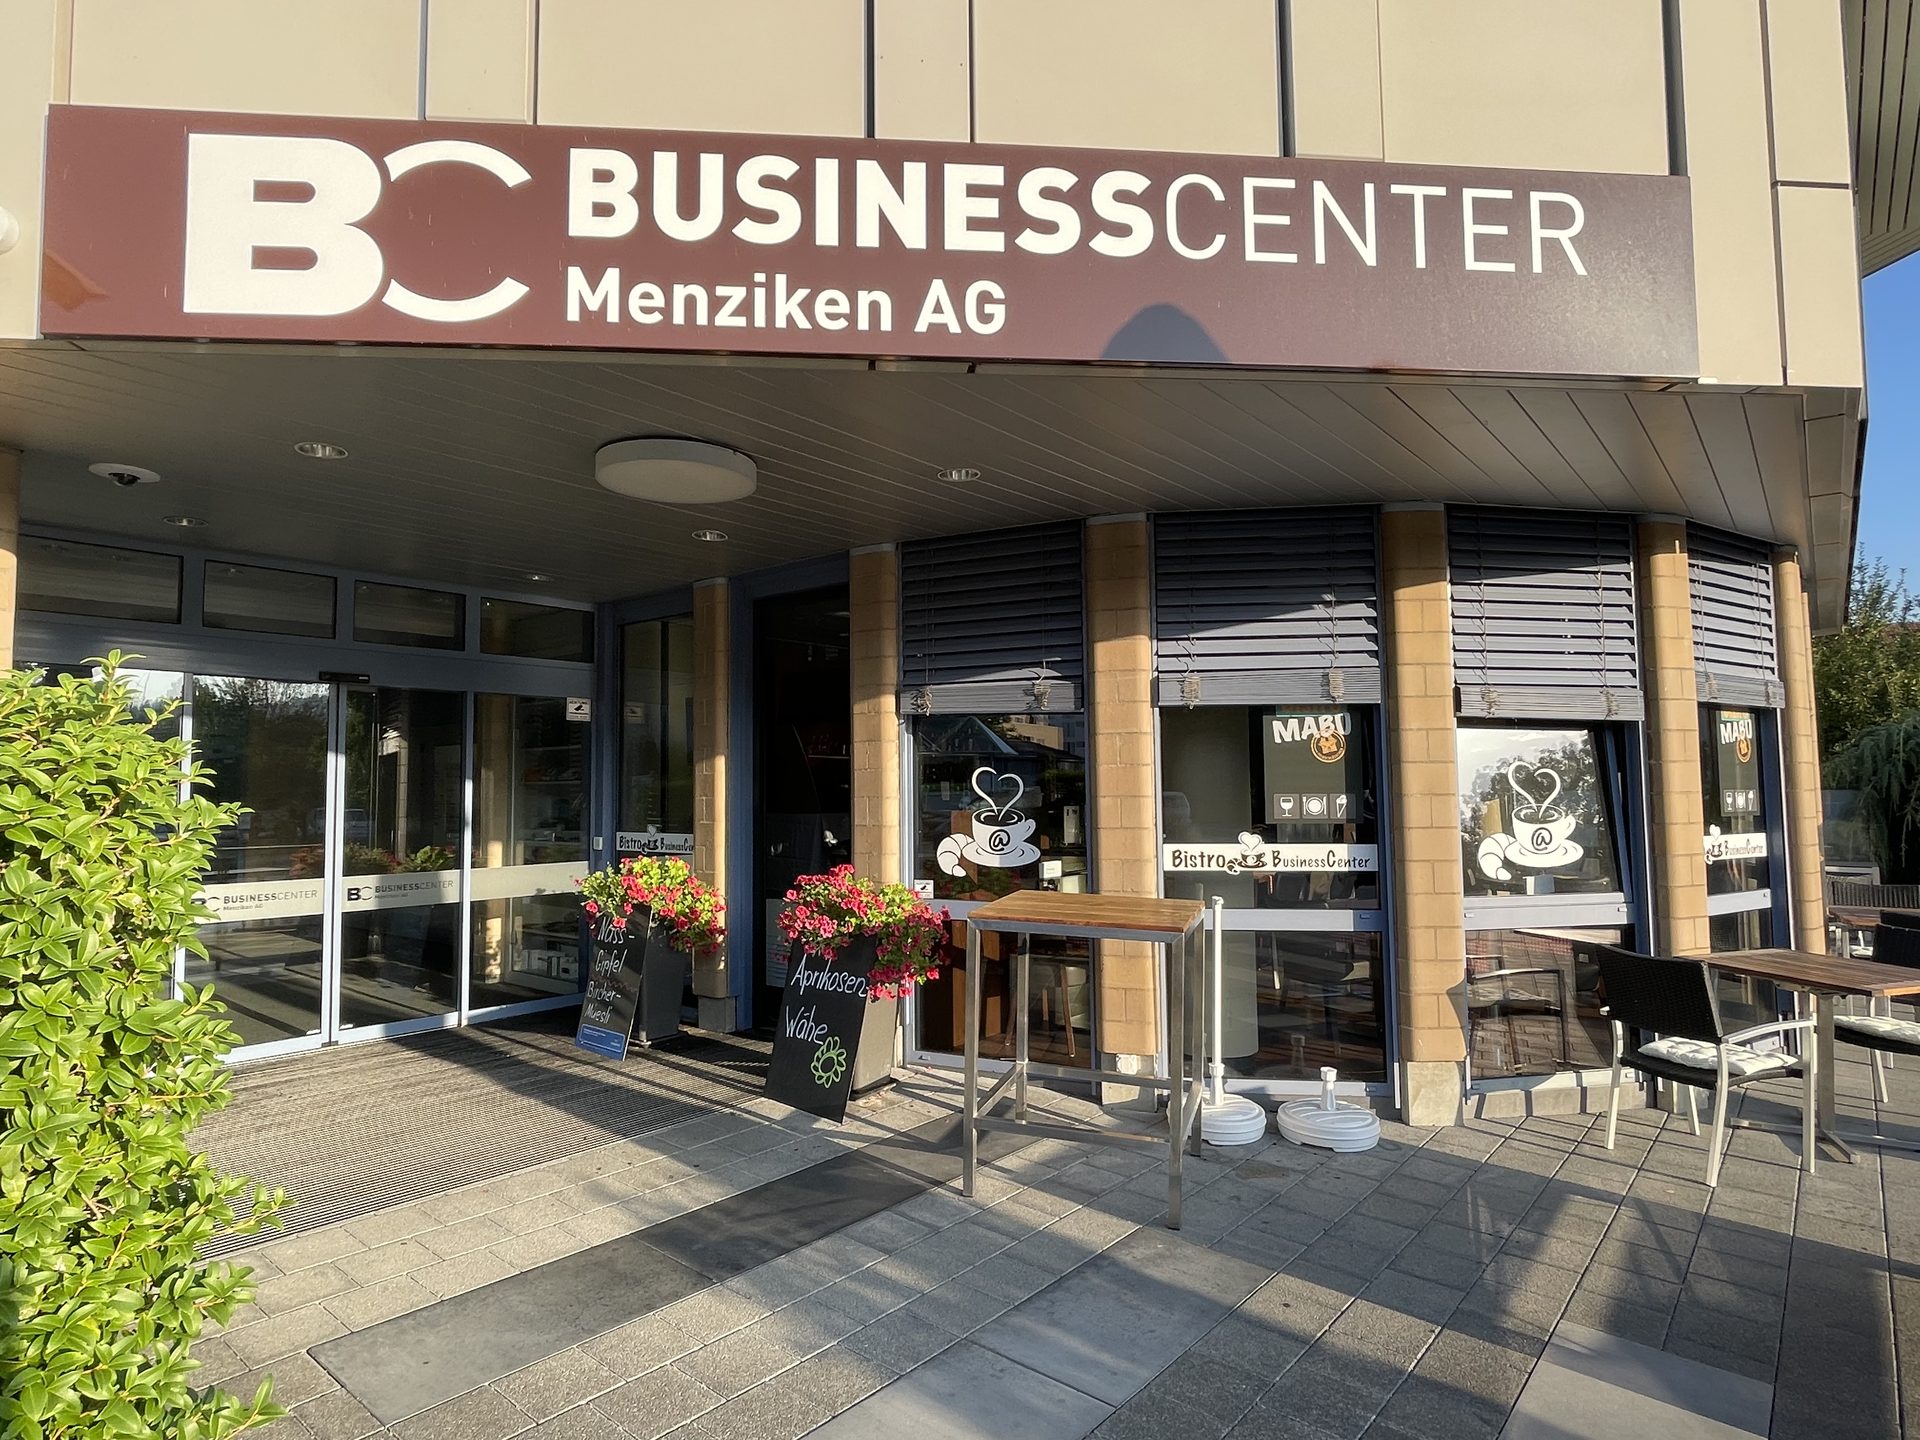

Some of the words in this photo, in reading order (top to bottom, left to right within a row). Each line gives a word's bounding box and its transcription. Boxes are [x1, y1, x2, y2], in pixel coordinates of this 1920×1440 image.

[568, 147, 1590, 277] BUSINESSCENTER
[182, 132, 532, 322] BC
[566, 266, 893, 332] Menziken
[913, 278, 1007, 335] AG
[1272, 712, 1352, 743] MABU
[619, 835, 642, 849] Bistro
[1171, 849, 1226, 868] Bistro
[1272, 850, 1371, 868] BusinessCenter
[223, 889, 318, 904] BUSINESSCENTER
[375, 880, 454, 893] BUSINESSCENTER
[595, 949, 628, 977] Gipfel
